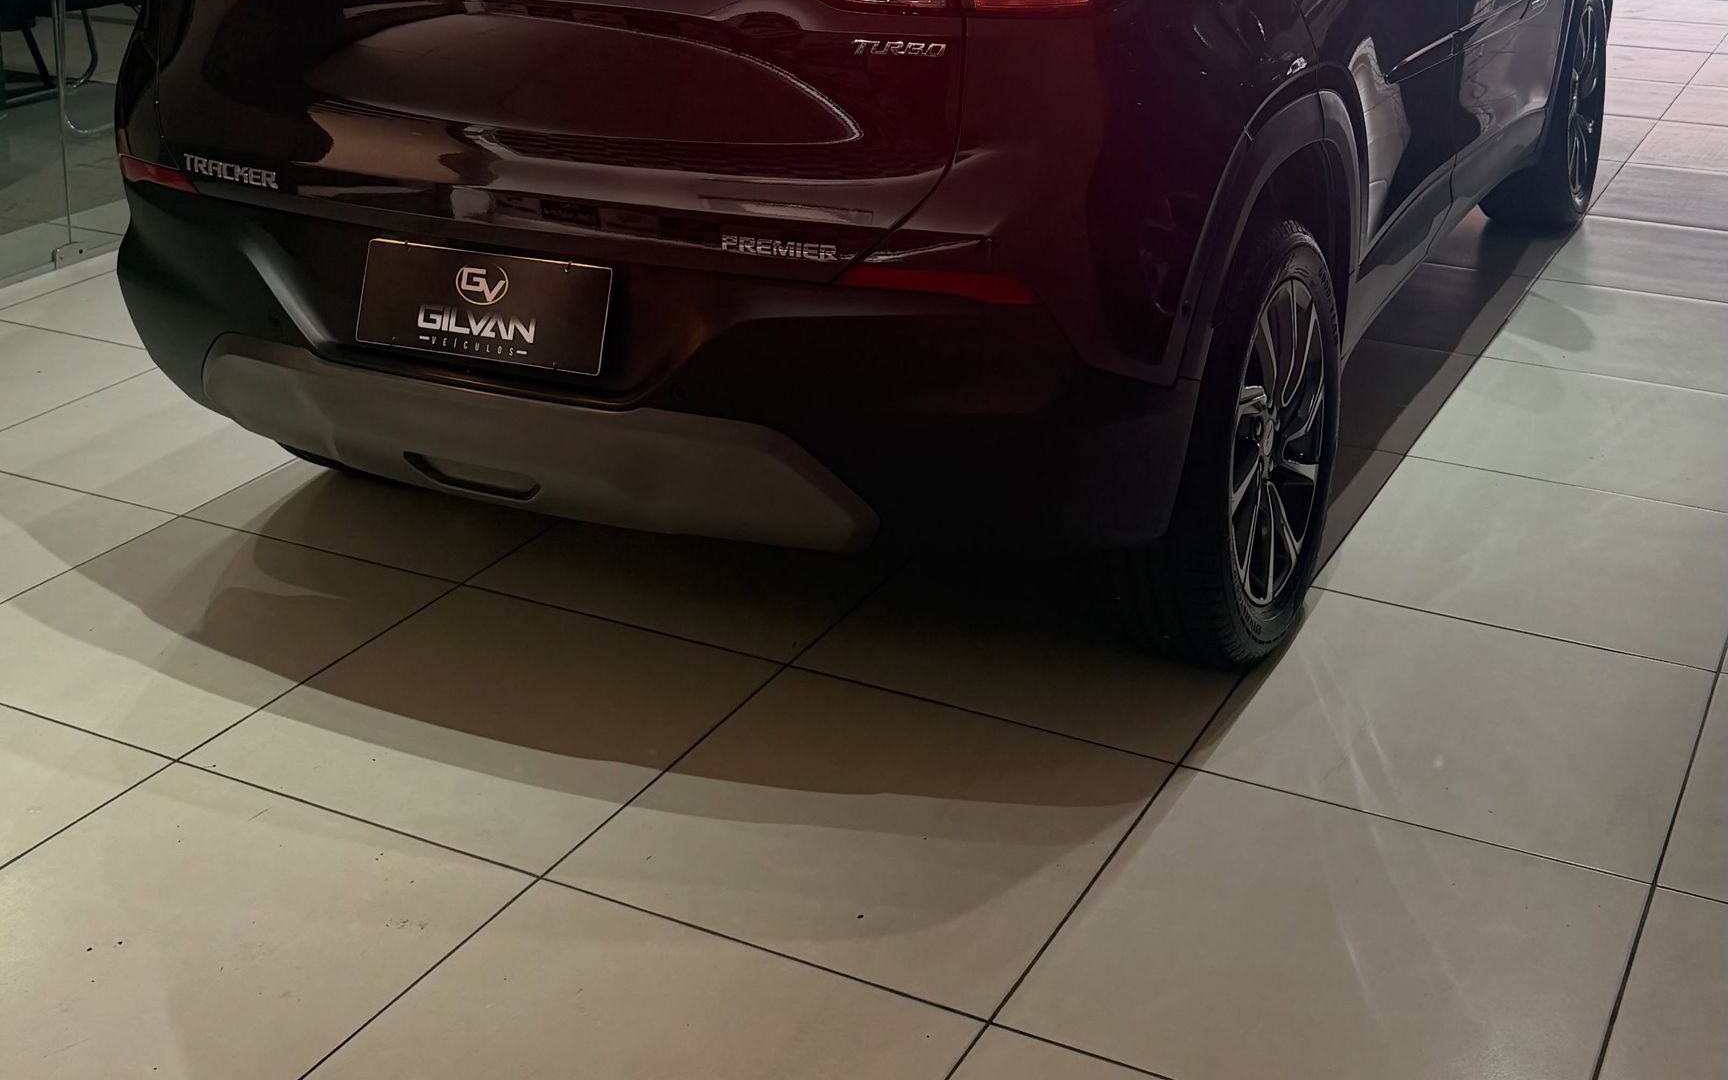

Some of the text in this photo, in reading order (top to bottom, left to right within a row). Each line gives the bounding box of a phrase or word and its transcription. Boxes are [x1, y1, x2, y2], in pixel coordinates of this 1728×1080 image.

[853, 39, 947, 57] TURBO
[184, 153, 278, 189] TRACKER
[722, 235, 838, 261] PREMIER
[461, 267, 505, 302] GV
[417, 305, 536, 344] GILVAN
